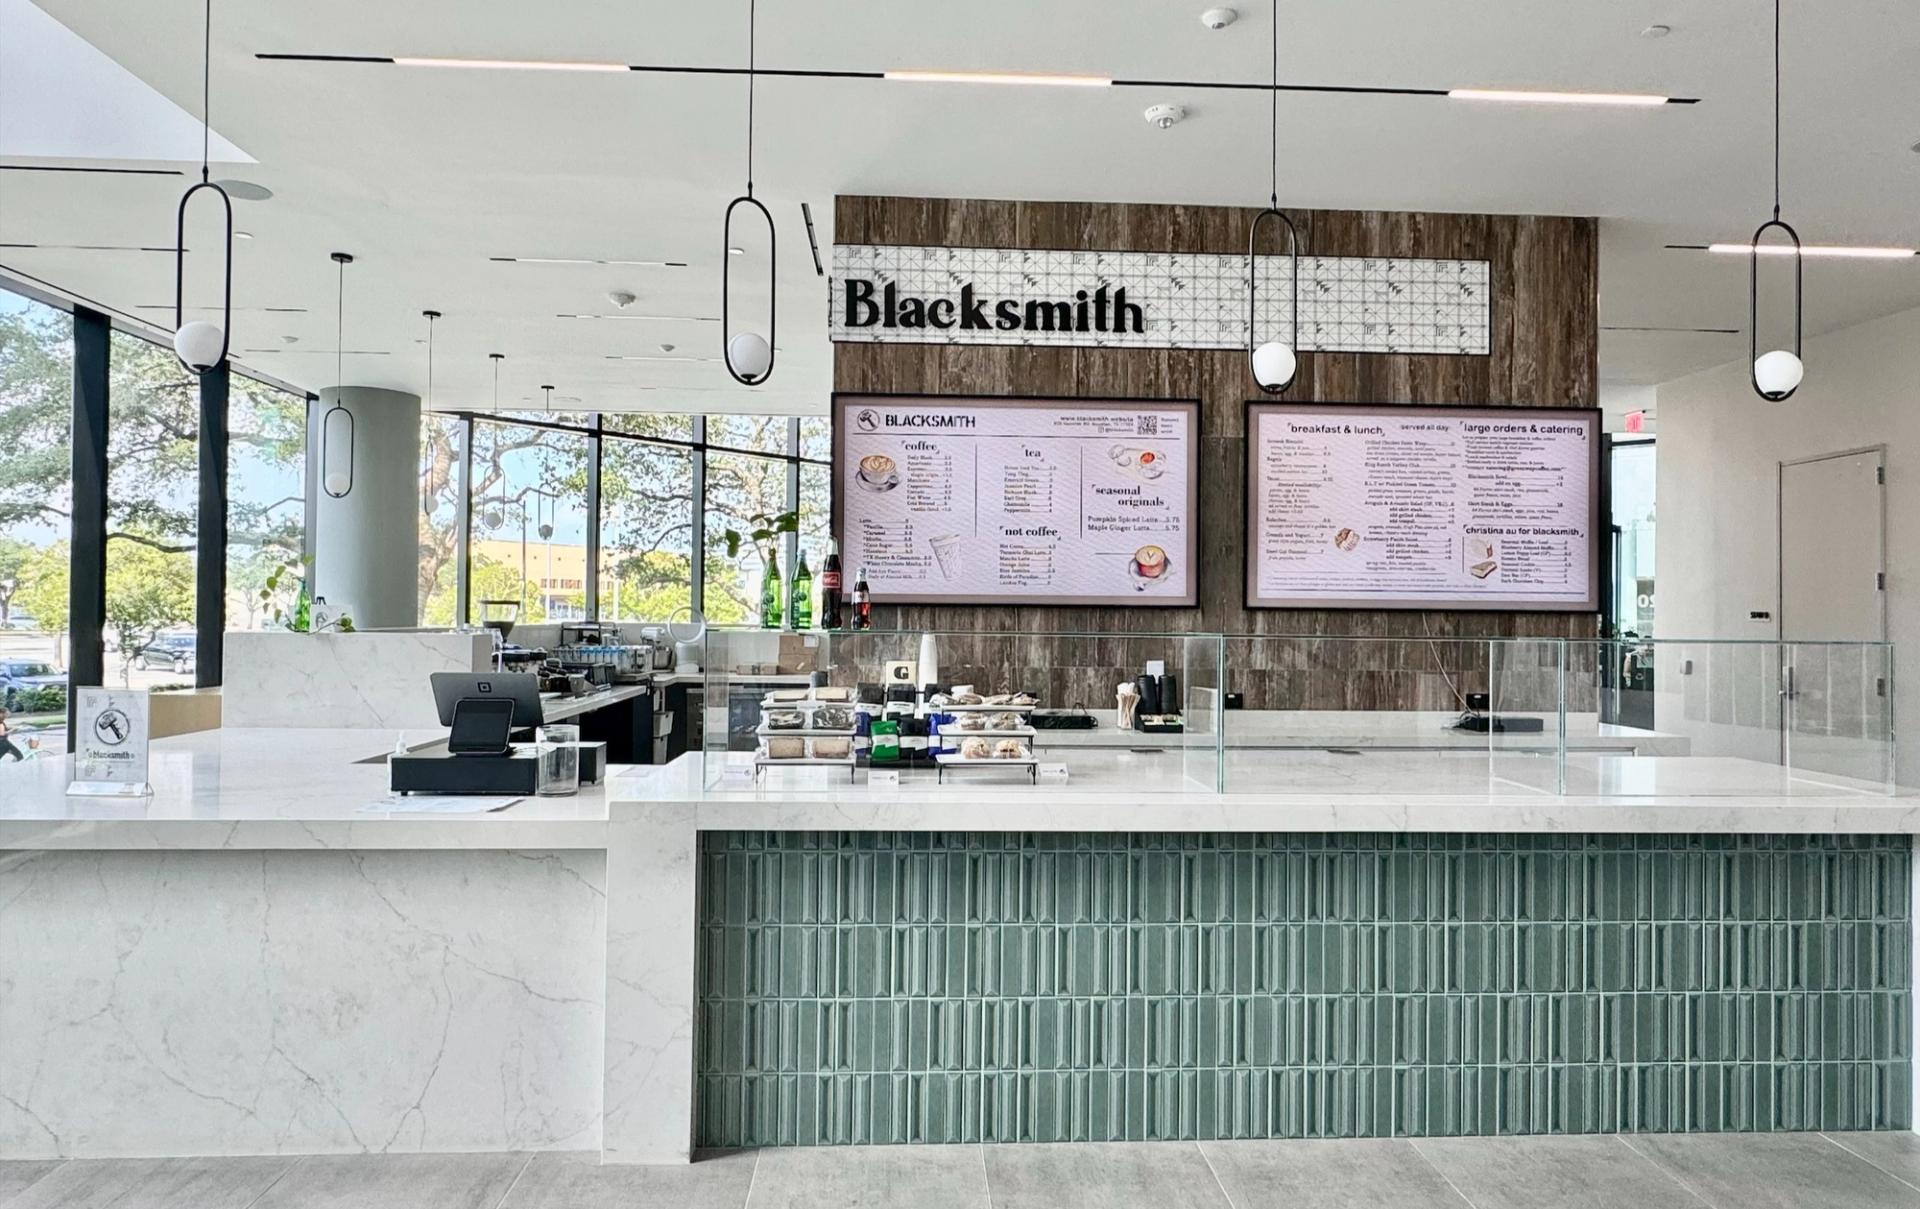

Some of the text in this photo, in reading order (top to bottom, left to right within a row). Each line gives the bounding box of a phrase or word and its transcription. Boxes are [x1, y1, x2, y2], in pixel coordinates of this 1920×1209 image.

[845, 279, 1144, 333] Blacksmith
[885, 414, 976, 428] BLACKSMITH
[1291, 424, 1383, 434] breakfast & lunch
[1464, 424, 1583, 436] large orders & catering
[905, 441, 937, 451] coffee
[1025, 449, 1040, 457] tea
[1096, 485, 1140, 495] seasonal
[1118, 496, 1164, 508] originals
[1005, 526, 1058, 536] not coffee
[894, 666, 909, 680] G
